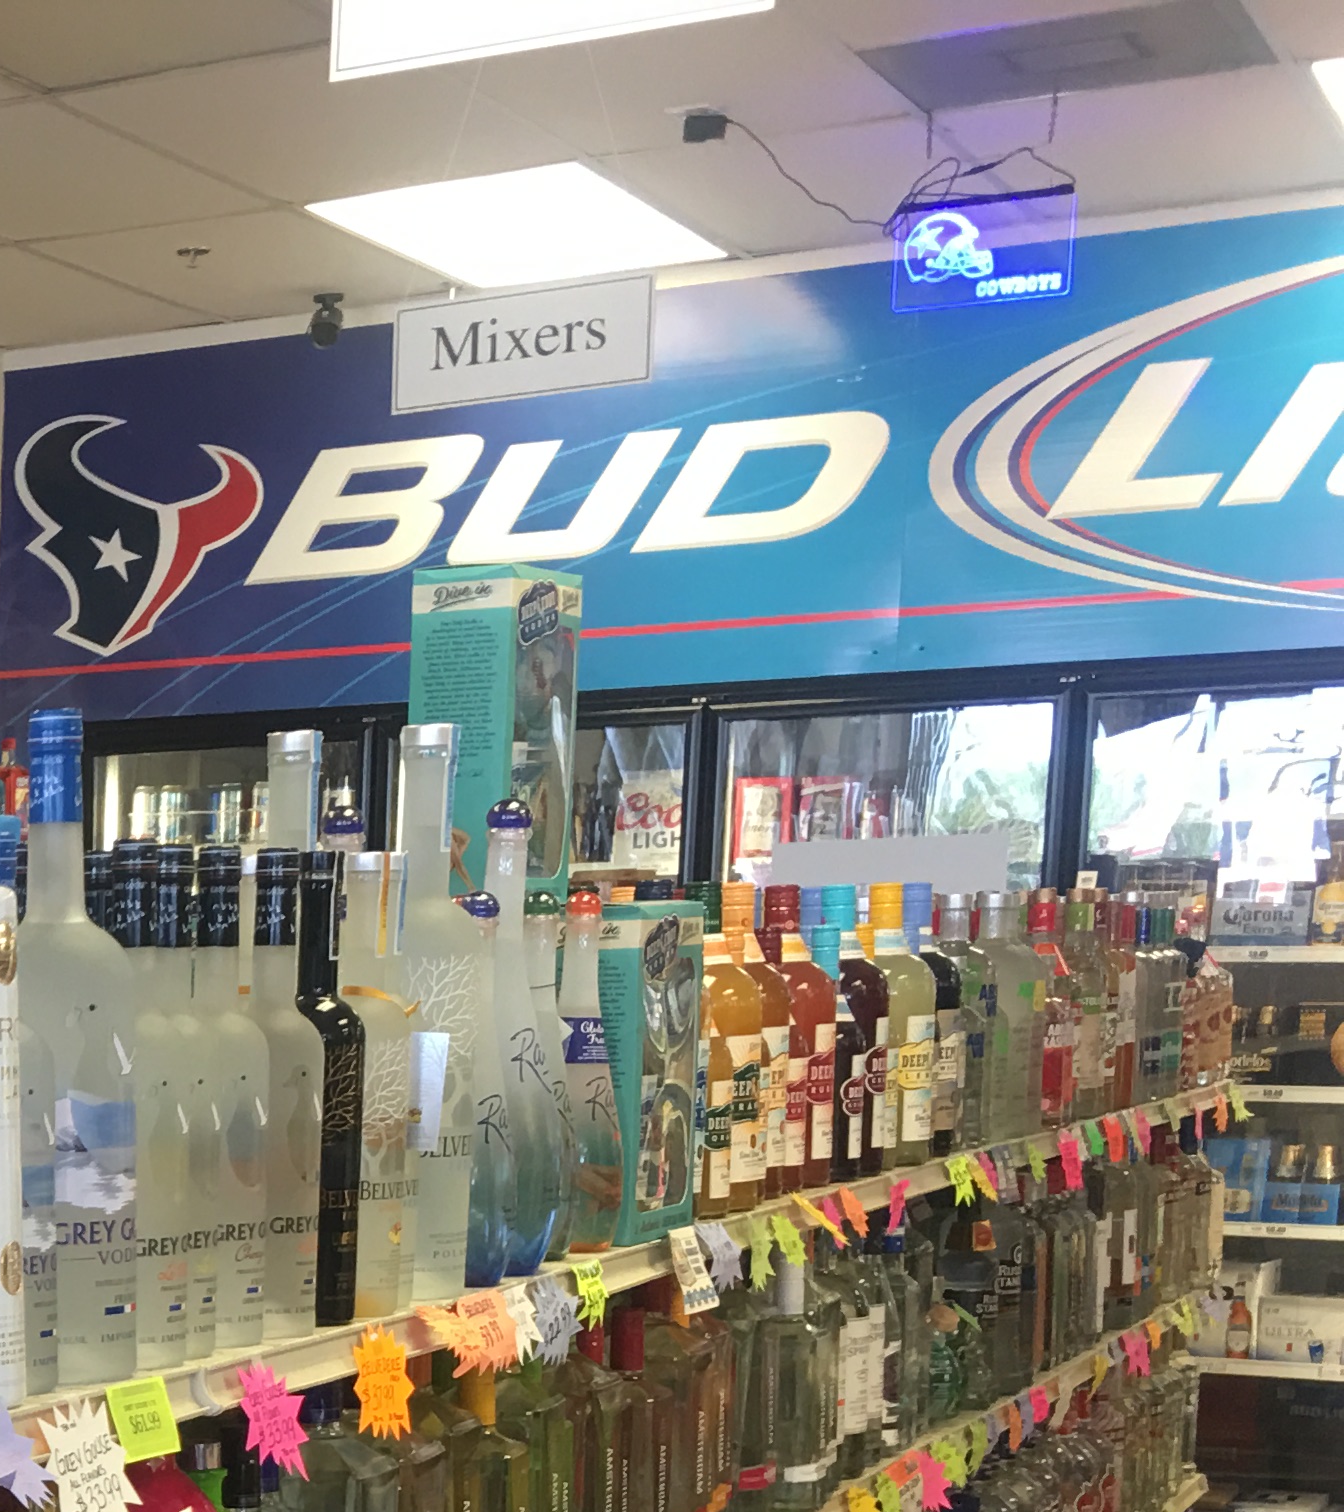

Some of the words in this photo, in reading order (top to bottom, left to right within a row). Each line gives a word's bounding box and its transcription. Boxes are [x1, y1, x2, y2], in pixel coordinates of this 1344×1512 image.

[429, 316, 608, 371] Mixers
[1045, 356, 1344, 521] LI
[242, 410, 891, 587] BUD
[615, 789, 682, 832] Coo
[1221, 902, 1295, 924] Corona
[900, 1051, 930, 1069] DEEP
[54, 1218, 116, 1247] GREY
[268, 1214, 312, 1235] GREY
[54, 1446, 82, 1478] GREY
